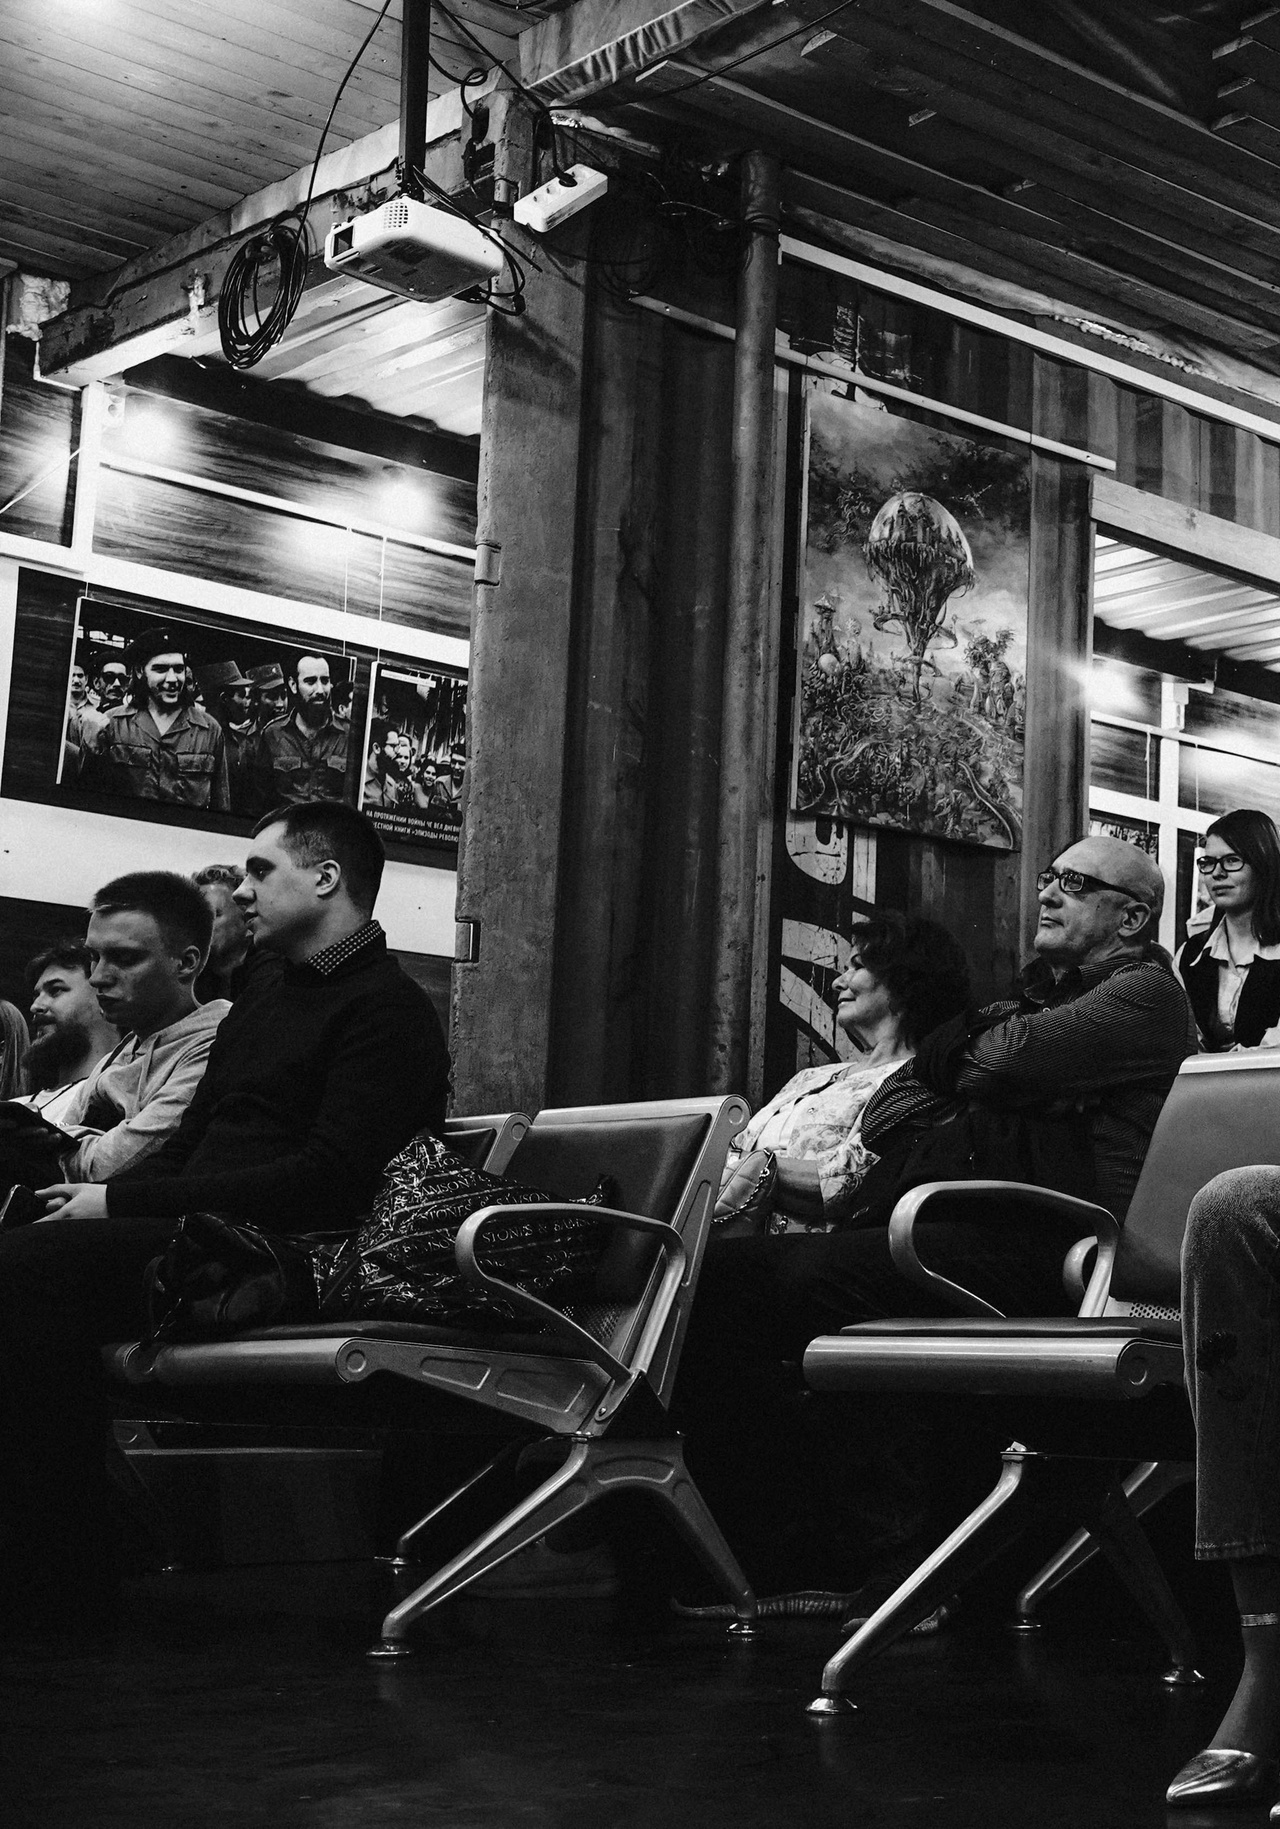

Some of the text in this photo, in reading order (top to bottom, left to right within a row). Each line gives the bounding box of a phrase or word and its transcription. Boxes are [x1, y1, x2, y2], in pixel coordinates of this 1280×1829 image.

[366, 810, 373, 818] НА
[374, 811, 407, 823] ПРОТЯЖЕНИИ
[408, 818, 426, 827] ВОЙНЫ
[426, 821, 433, 829] ЧЕ
[434, 822, 443, 830] ВЕЛ
[394, 825, 411, 834] КНИГИ
[413, 1174, 471, 1198] SAMSON
